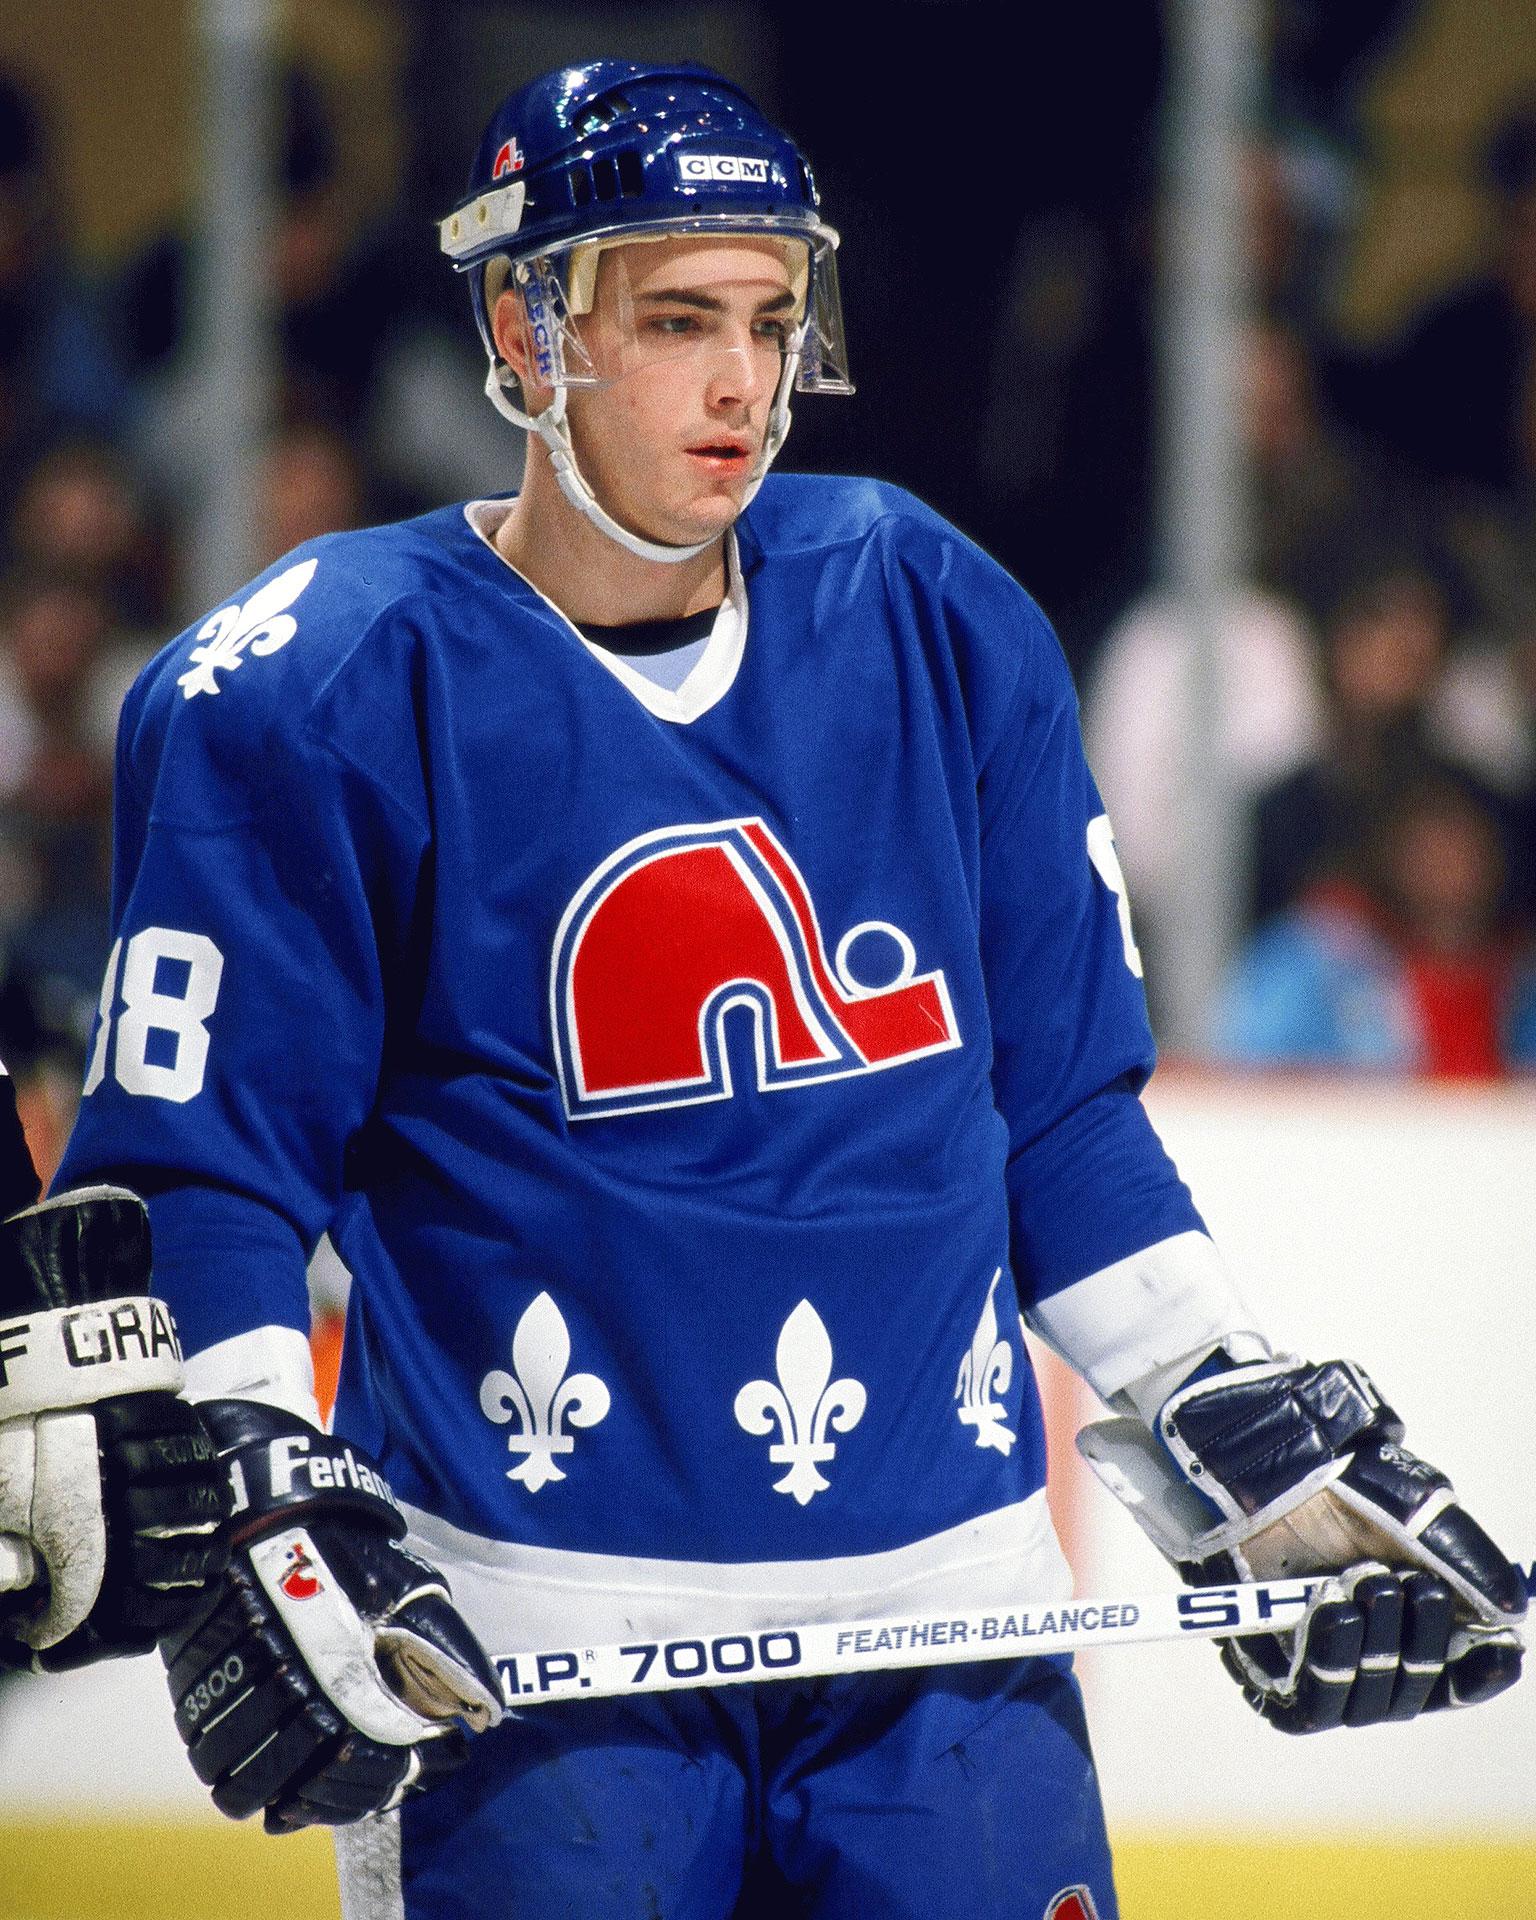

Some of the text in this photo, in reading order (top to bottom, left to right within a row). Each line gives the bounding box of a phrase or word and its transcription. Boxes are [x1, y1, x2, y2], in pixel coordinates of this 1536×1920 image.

[686, 159, 763, 178] CCM
[82, 926, 224, 1104] 8
[61, 1303, 183, 1368] GRA
[183, 1654, 244, 1722] 3300
[619, 1631, 801, 1684] 7000
